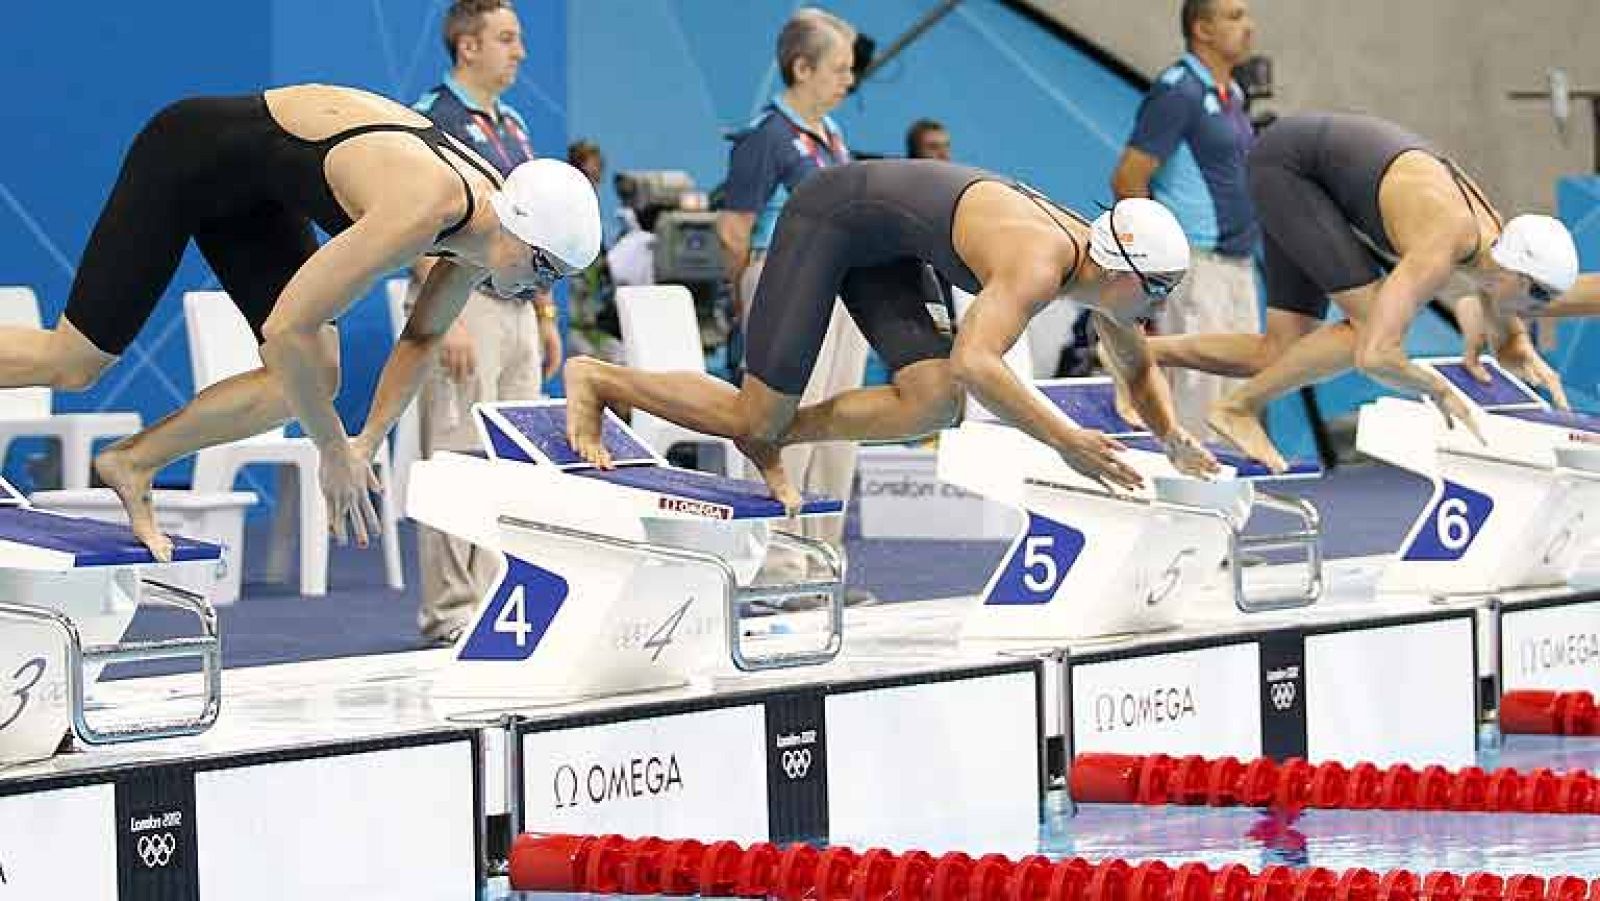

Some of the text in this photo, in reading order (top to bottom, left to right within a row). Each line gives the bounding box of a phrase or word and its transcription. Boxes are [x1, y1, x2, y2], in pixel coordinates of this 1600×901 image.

[1437, 497, 1470, 550] 6
[1024, 537, 1056, 592] 5
[493, 583, 532, 647] 4
[643, 596, 695, 662] 4
[0, 656, 47, 731] 3
[1120, 684, 1196, 727] OMEGA
[587, 752, 684, 803] OMEGA
[130, 816, 161, 832] London
